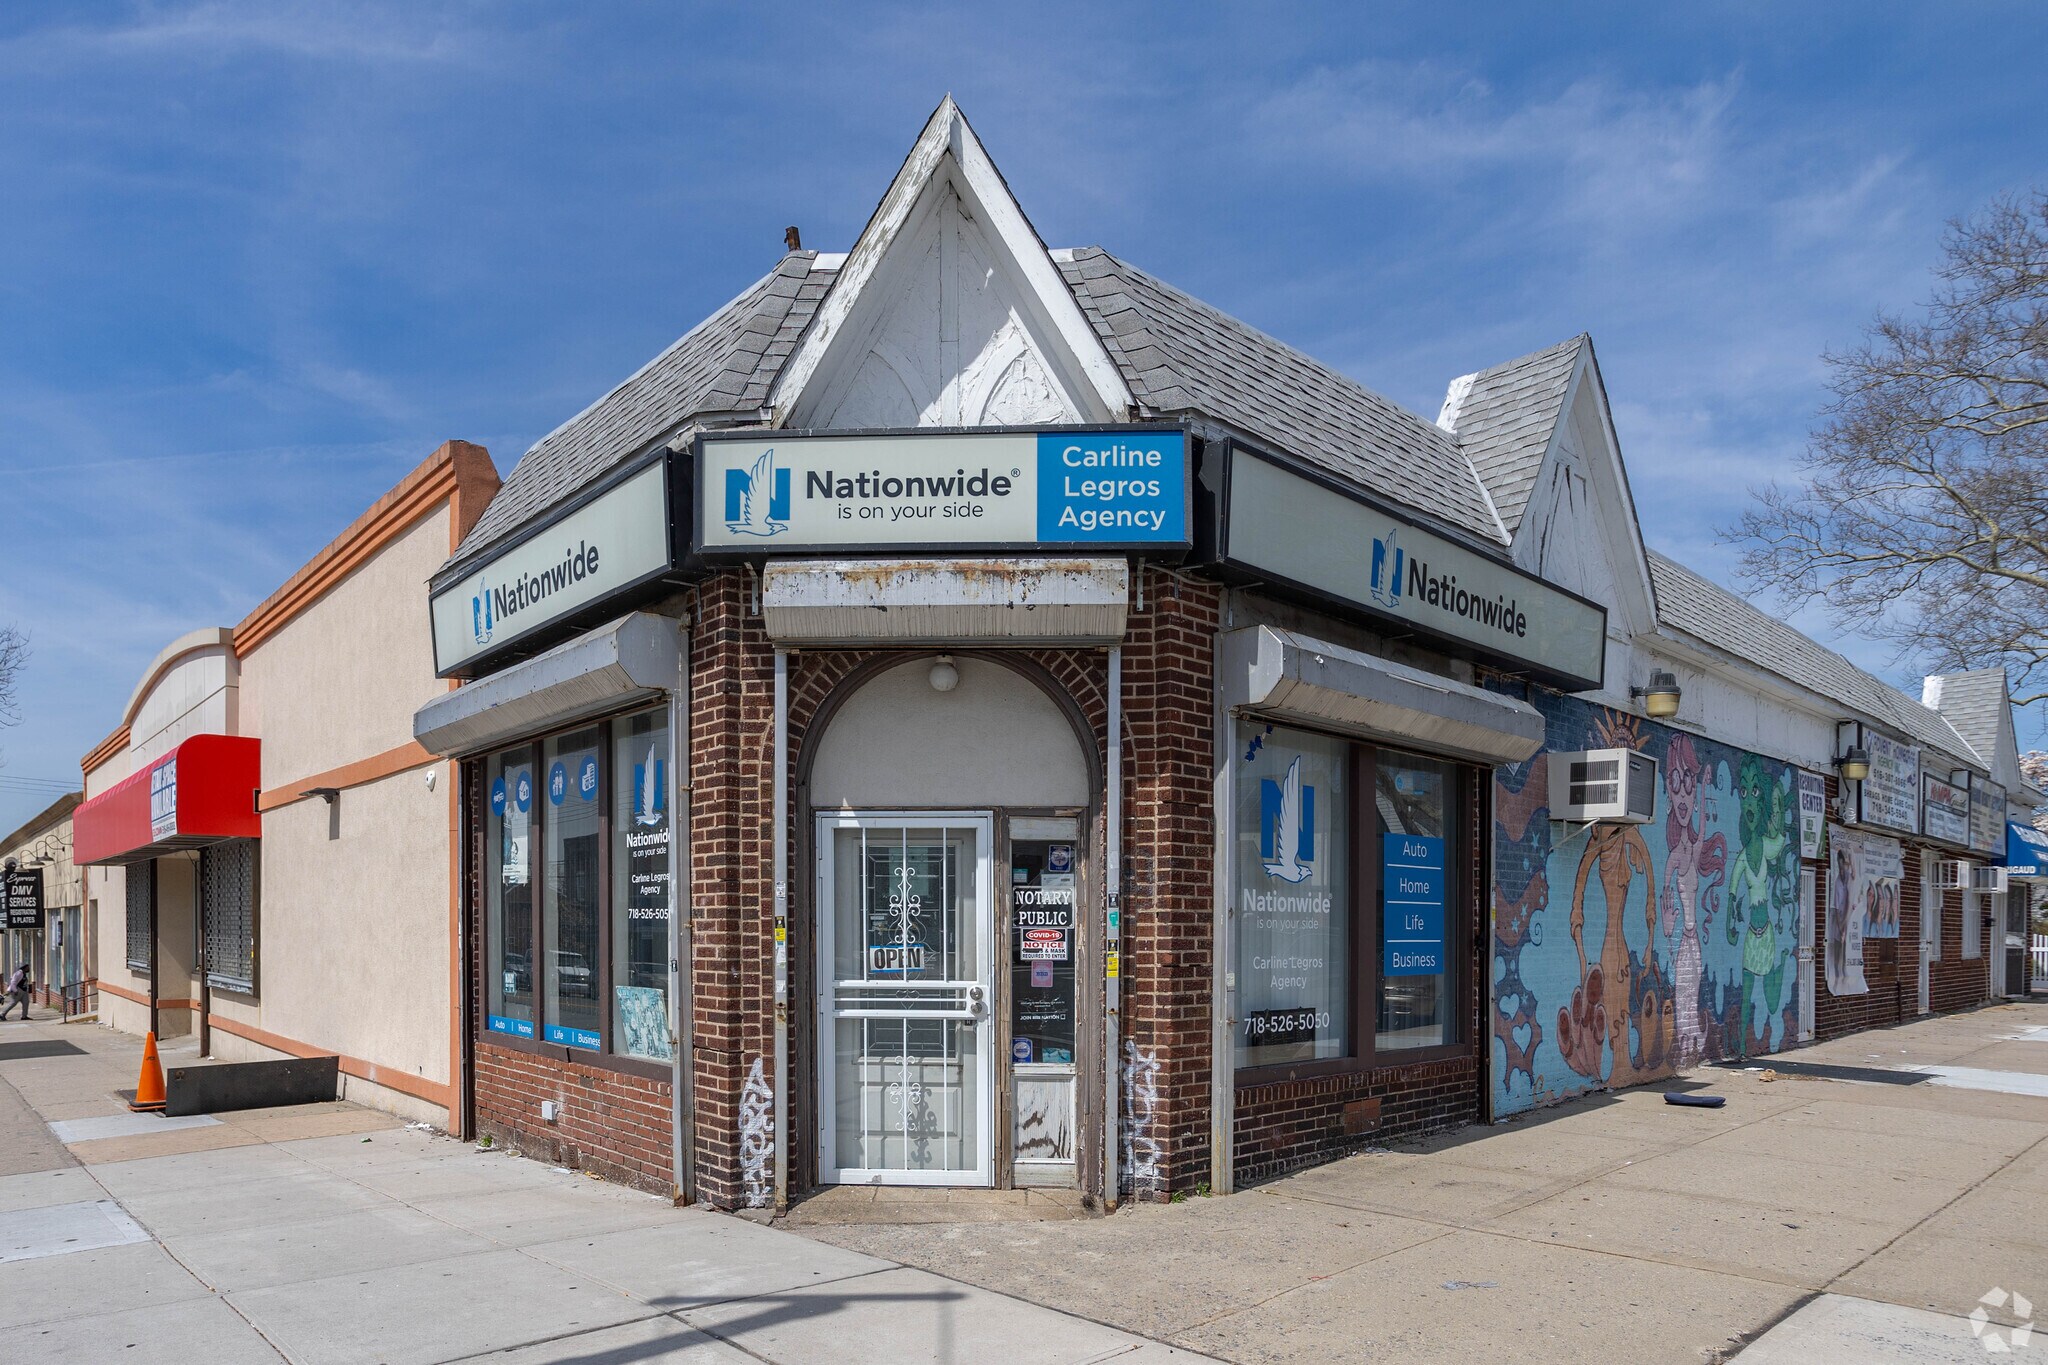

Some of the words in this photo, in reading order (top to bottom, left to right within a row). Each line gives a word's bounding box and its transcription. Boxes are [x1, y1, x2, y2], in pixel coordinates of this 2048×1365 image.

[1062, 445, 1162, 468] Carline
[1063, 476, 1161, 501] Legros
[837, 502, 851, 520] is
[860, 505, 883, 520] on
[890, 504, 936, 523] your
[943, 500, 984, 519] side
[1058, 505, 1166, 532] Agency
[494, 540, 599, 622] Nationwide
[1408, 557, 1527, 638] Nationwide
[626, 828, 671, 848] Nationwid
[644, 848, 656, 858] your
[656, 846, 667, 855] side
[1402, 841, 1428, 858] Auto
[631, 873, 650, 884] Carline
[650, 872, 670, 882] Legros
[1399, 877, 1430, 894] Home
[11, 885, 33, 896] DMV
[640, 885, 661, 896] Agency
[1015, 890, 1071, 905] NOTARY
[9, 896, 37, 908] SERVICES
[17, 916, 36, 924] PLATES
[628, 908, 671, 920] 718-526-505
[1018, 911, 1068, 926] PUBLIC
[1405, 914, 1425, 930] Life
[1256, 915, 1264, 929] is
[1266, 918, 1278, 929] on
[1280, 919, 1300, 932] your
[1301, 916, 1319, 930] side
[874, 948, 921, 970] OPEN
[1253, 955, 1291, 970] Carline
[1291, 956, 1323, 971] Legros
[1392, 952, 1436, 968] Business
[1270, 975, 1307, 990] Agency
[494, 1020, 506, 1030] Auto
[518, 1023, 532, 1034] Home
[1243, 1012, 1330, 1035] 718-526-5050
[553, 1029, 564, 1040] Life
[577, 1033, 601, 1047] Business
